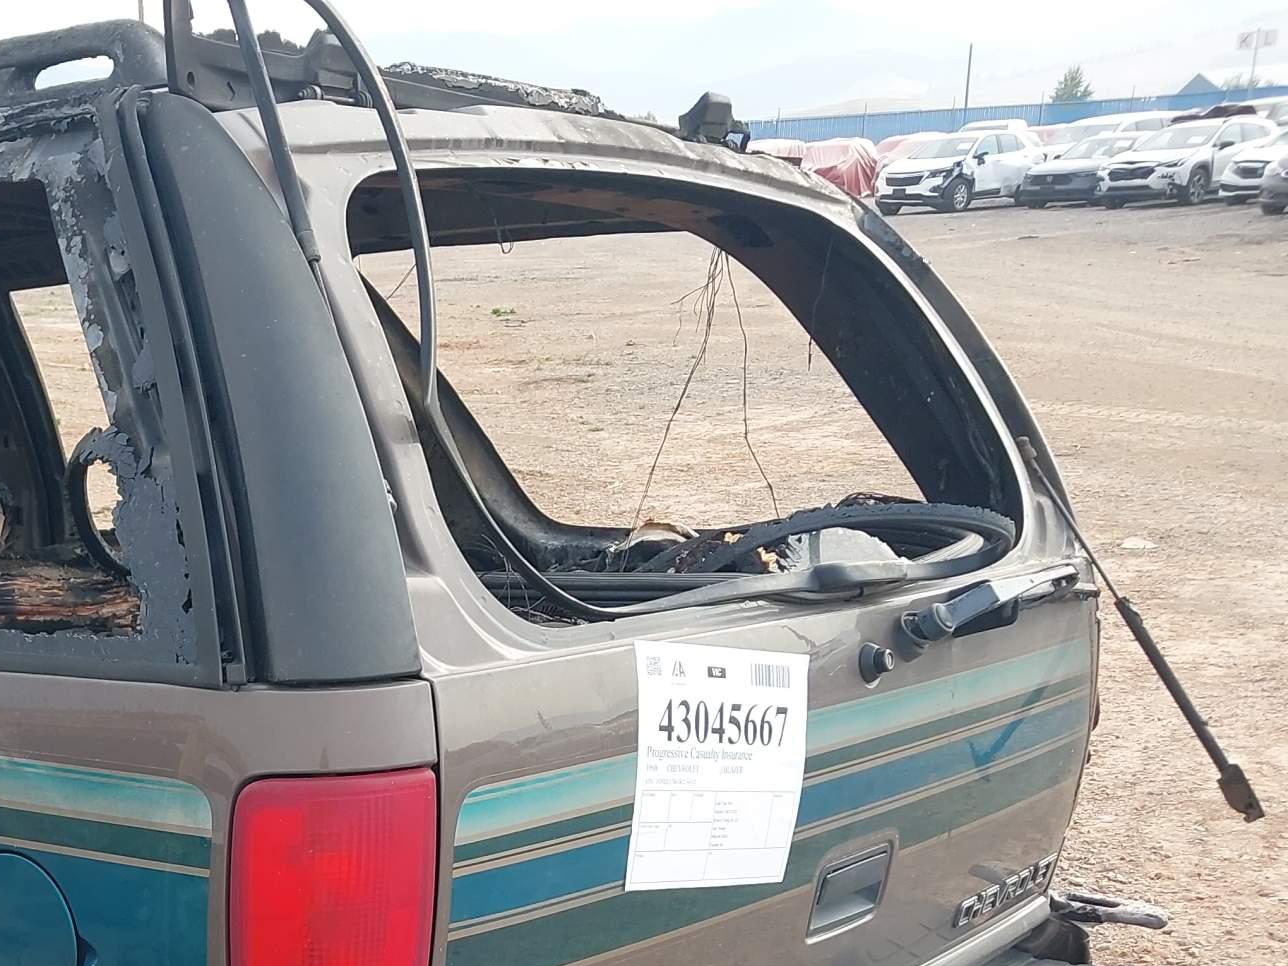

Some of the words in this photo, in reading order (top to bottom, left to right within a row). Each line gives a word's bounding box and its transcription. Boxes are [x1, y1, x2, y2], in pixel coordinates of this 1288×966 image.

[658, 698, 789, 747] 43045667
[647, 745, 688, 760] Progressive
[690, 747, 720, 762] Casualty
[722, 749, 753, 761] Insurance
